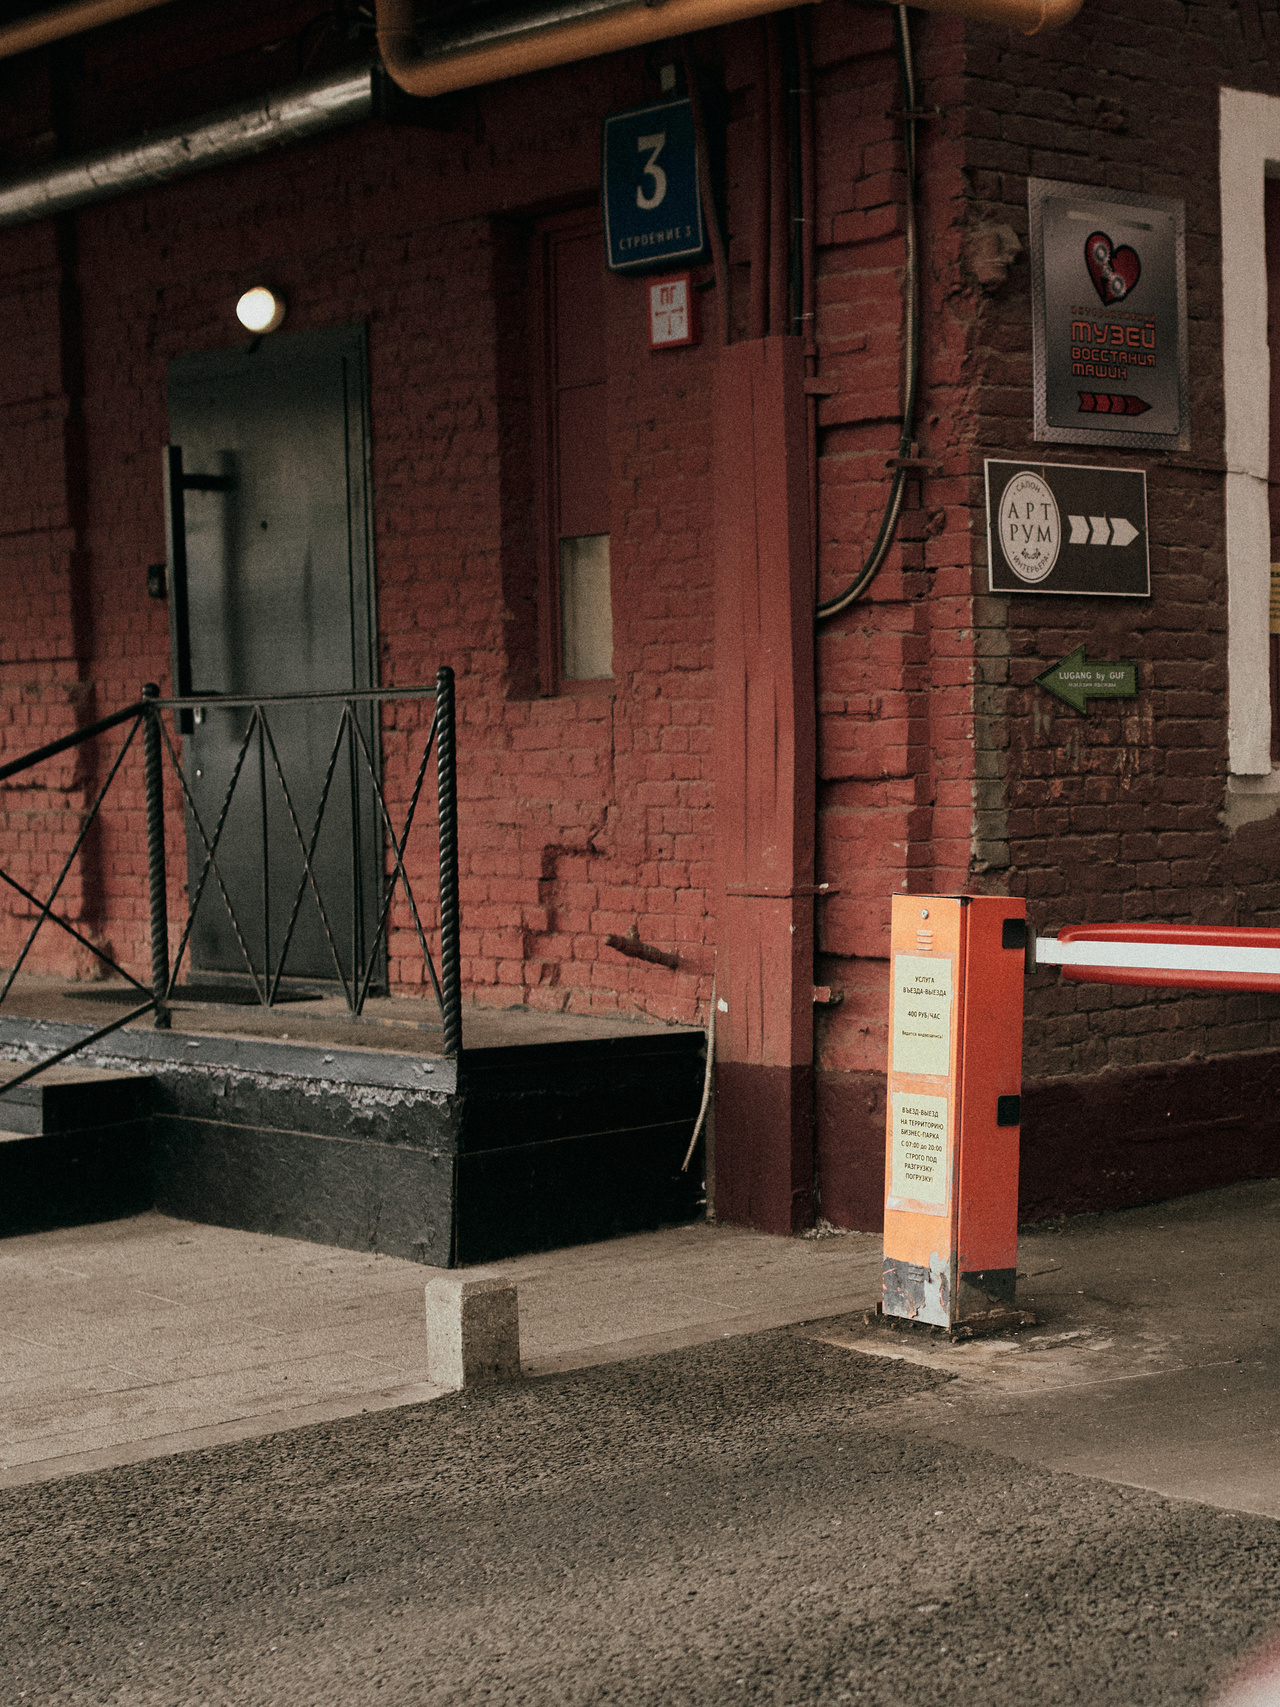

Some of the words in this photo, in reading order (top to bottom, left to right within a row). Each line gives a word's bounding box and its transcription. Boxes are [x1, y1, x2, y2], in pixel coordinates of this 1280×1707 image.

[636, 131, 667, 210] 3
[619, 226, 681, 250] СТРОЕНИЕ
[685, 225, 691, 237] 3
[660, 285, 676, 305] ПГ
[1072, 321, 1155, 348] МУЗЕЙ
[1072, 347, 1156, 366] ВОССТАНИЯ
[1072, 363, 1127, 379] МАШИН
[1016, 481, 1041, 493] САЛОН
[1008, 501, 1051, 520] АРТ
[1010, 523, 1052, 543] РУМ
[1013, 555, 1050, 573] ИНТЕРЬЕРА
[1059, 671, 1092, 680] LUGANG
[1096, 672, 1105, 682] by
[1109, 671, 1125, 680] GUF
[902, 986, 947, 997] ВЪЕЗДА-ВЫЕЗДА
[907, 1010, 917, 1018] 400
[918, 1011, 941, 1020] РУБ/ЧАС
[901, 1106, 939, 1118] ВЪЕЗД-ВЫЕЗД
[909, 1119, 944, 1130] ТЕРРИТОРИЮ
[900, 1128, 940, 1140] БИЗНЕС-ПАРКА
[905, 1140, 920, 1149] 07:00
[928, 1144, 943, 1152] 20:00
[905, 1152, 925, 1161] СТРОГО
[925, 1155, 937, 1164] ПОД
[904, 1162, 935, 1173] РАЗГРУЗКУ-
